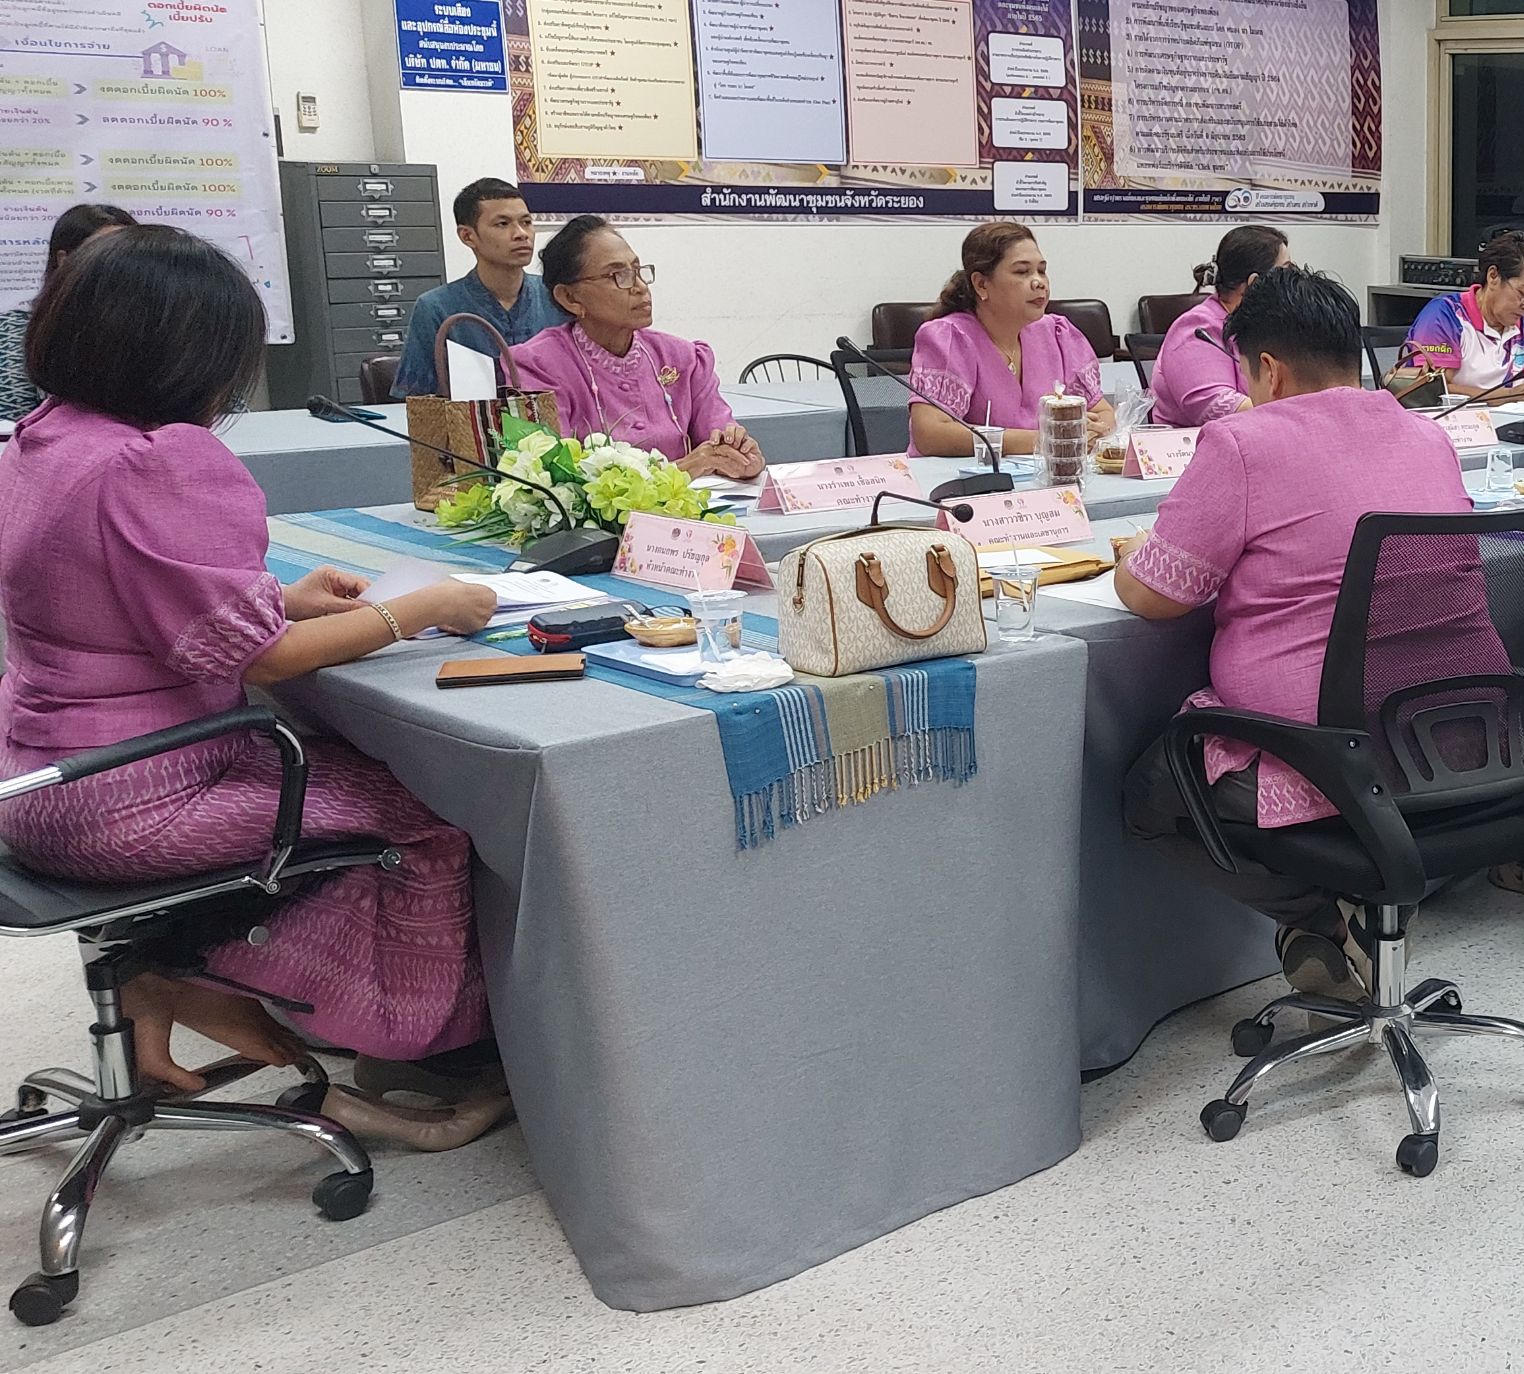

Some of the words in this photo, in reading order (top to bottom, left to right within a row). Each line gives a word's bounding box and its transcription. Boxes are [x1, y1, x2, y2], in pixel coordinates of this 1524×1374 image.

[404, 53, 427, 68] บริษัท
[450, 55, 471, 71] จำกัด
[193, 89, 227, 98] 100%
[202, 118, 220, 127] 90
[200, 158, 233, 167] 100%
[202, 184, 236, 193] 100%
[700, 187, 924, 214] สำนักงานพัฒนาชุมชนจังหวัดระยอง
[206, 209, 223, 218] 90
[645, 559, 700, 579] หัวหน้าคณะทำงา
